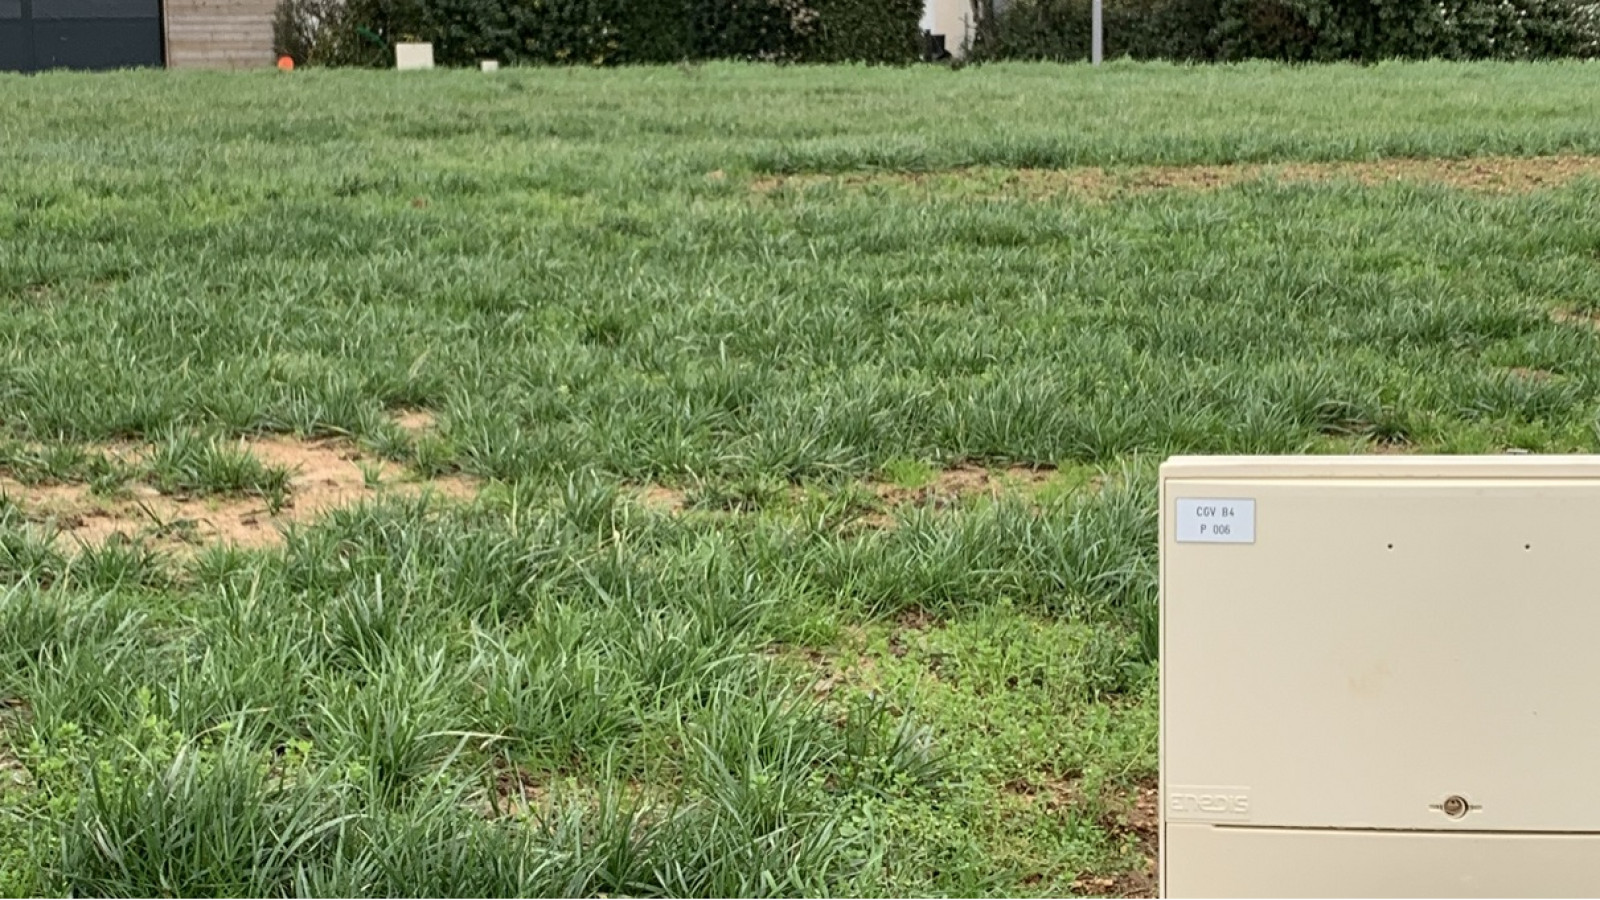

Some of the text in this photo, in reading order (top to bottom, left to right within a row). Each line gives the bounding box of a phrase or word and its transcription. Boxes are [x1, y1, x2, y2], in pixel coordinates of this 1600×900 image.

[1196, 506, 1235, 517] CGV B4
[1200, 524, 1231, 535] P 006
